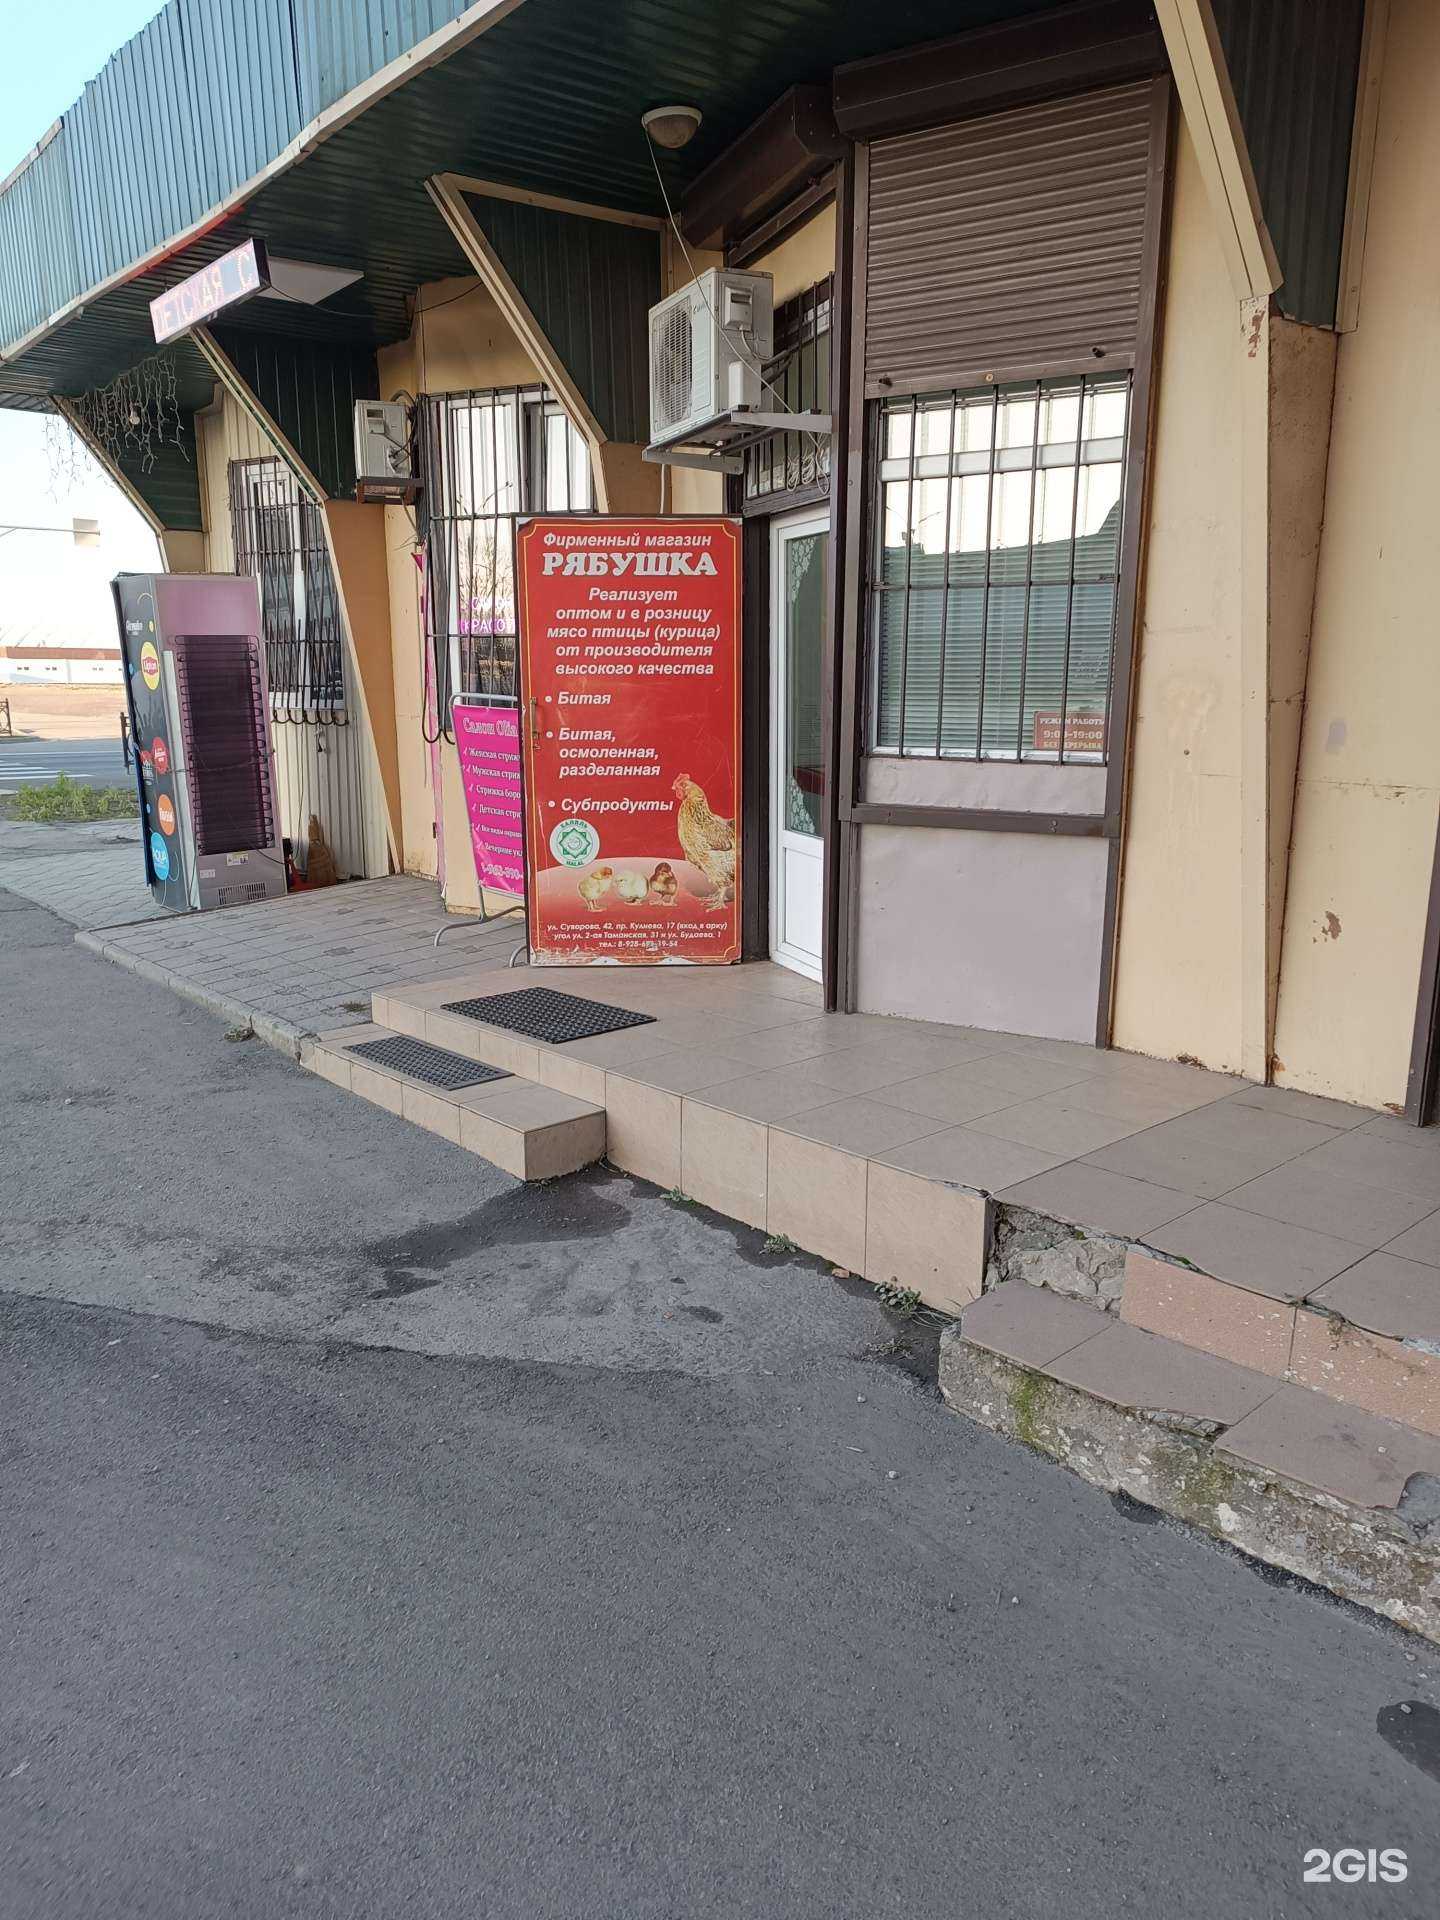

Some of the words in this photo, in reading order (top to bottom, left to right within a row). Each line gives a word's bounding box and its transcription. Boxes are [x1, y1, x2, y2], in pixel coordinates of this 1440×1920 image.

[543, 532, 640, 549] Фирменный
[644, 534, 712, 547] магазин
[541, 552, 718, 577] РЯБУШКА
[588, 587, 678, 604] Реализует
[555, 608, 612, 620] оптом
[616, 608, 626, 620] и
[630, 608, 640, 620] в
[643, 608, 712, 623] розницу
[546, 626, 588, 639] мясо
[591, 626, 650, 641] птицы
[654, 624, 721, 641] (курица)
[555, 645, 580, 657] от
[584, 642, 713, 660] производителя
[555, 662, 634, 675] высокого
[637, 662, 714, 675] качества
[557, 691, 612, 705] Битая
[558, 727, 617, 743] Битая,
[559, 747, 660, 761] осмоленная,
[558, 763, 661, 779] разделанная
[560, 797, 674, 814] Субпродукты
